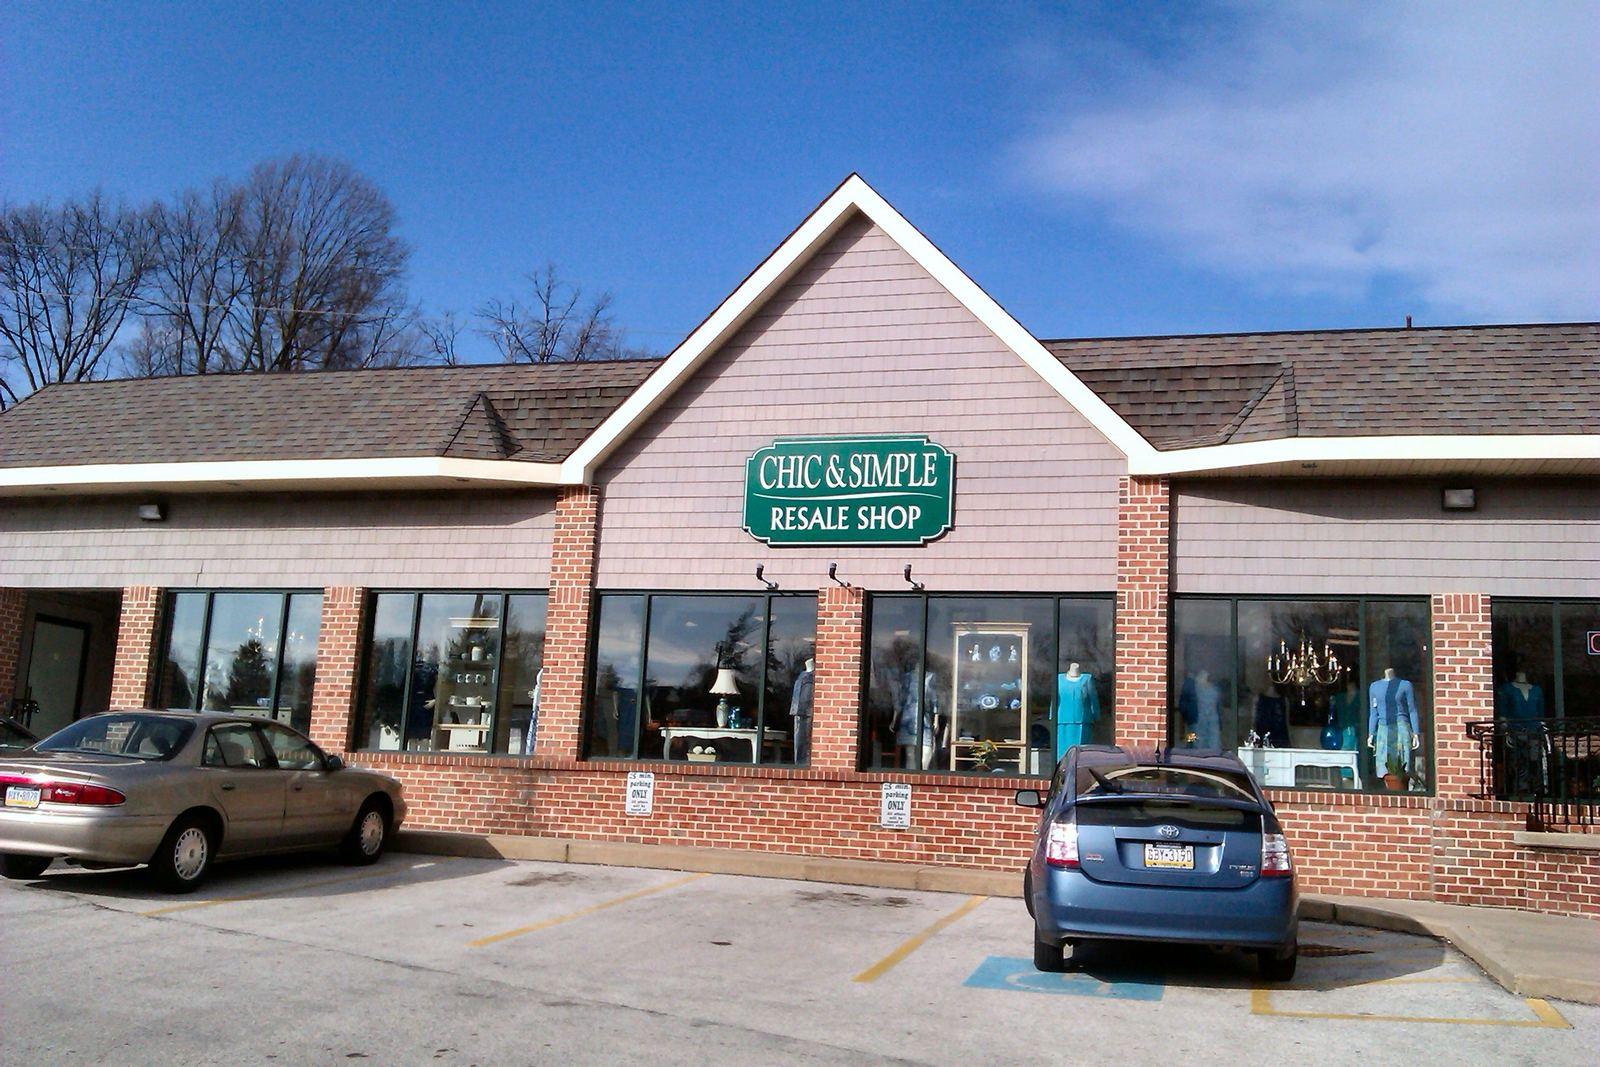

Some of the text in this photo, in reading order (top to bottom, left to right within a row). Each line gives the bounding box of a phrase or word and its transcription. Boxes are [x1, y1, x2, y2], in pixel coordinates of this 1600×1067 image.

[759, 452, 938, 490] CHIC & SIMPLE
[770, 504, 922, 531] RESALE SHOP
[631, 789, 648, 799] ONLY
[887, 800, 905, 811] ONLY
